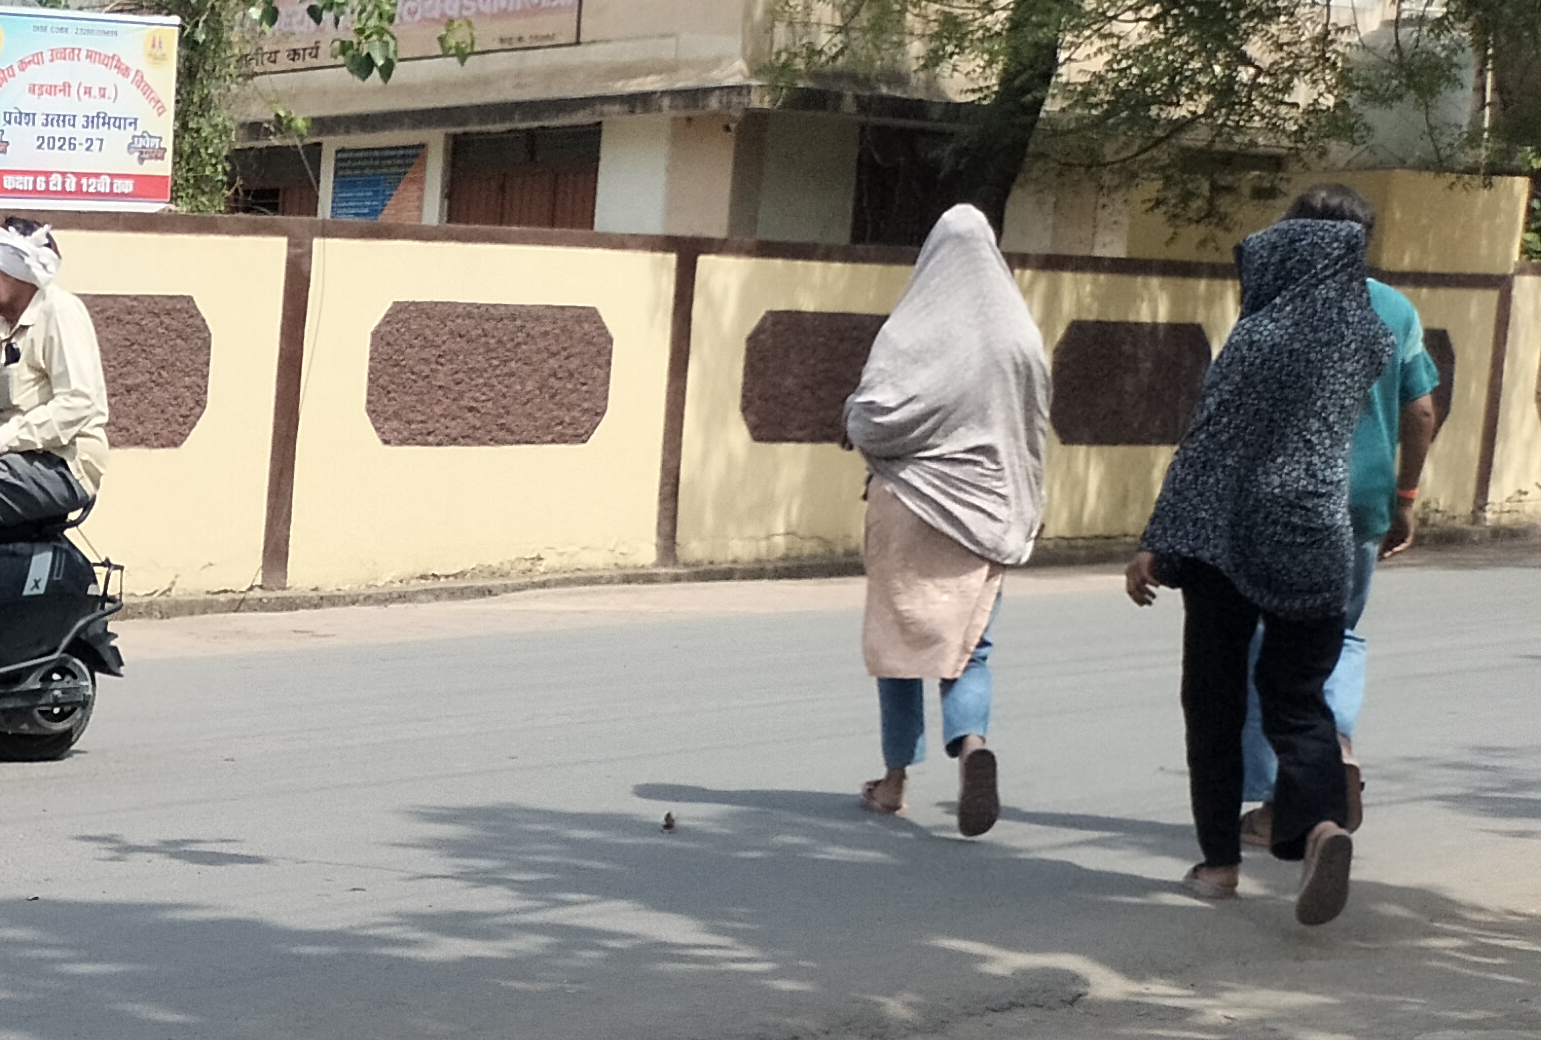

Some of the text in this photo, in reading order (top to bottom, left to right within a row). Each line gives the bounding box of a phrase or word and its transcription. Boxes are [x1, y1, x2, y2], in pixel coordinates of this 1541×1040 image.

[2, 106, 139, 131] प्रवेश उत्सव अभियान
[36, 135, 105, 154] 2026-27
[2, 175, 34, 191] कक्षा
[36, 175, 47, 191] 6
